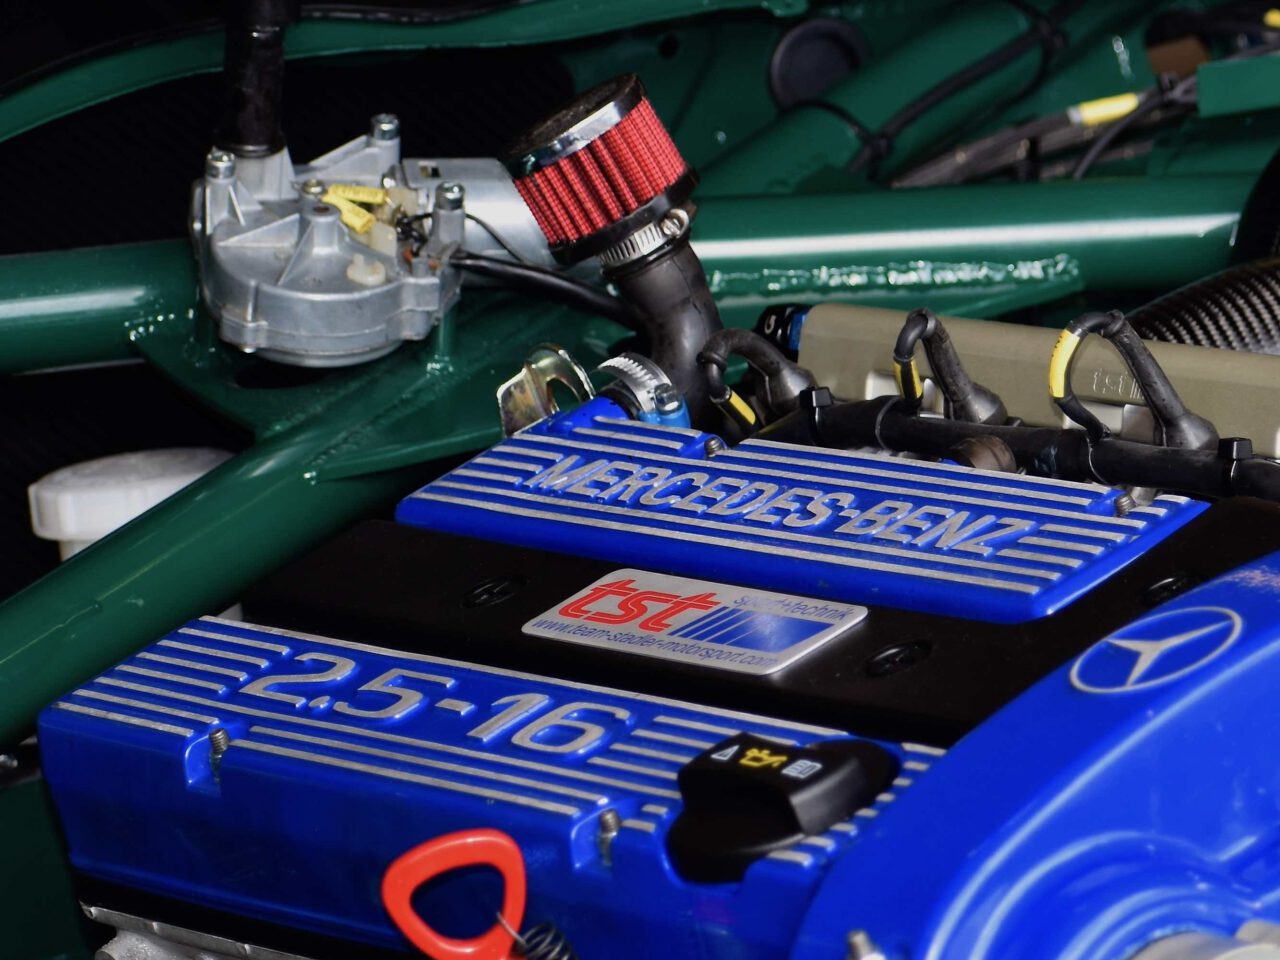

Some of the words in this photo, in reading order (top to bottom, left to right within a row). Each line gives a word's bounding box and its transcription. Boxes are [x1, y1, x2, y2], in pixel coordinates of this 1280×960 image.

[523, 454, 1036, 558] MERCEDES-BENZ
[531, 618, 779, 667] www.team-stadler-motorsport.com
[558, 578, 722, 634] tst
[238, 651, 633, 756] 2.5-16
